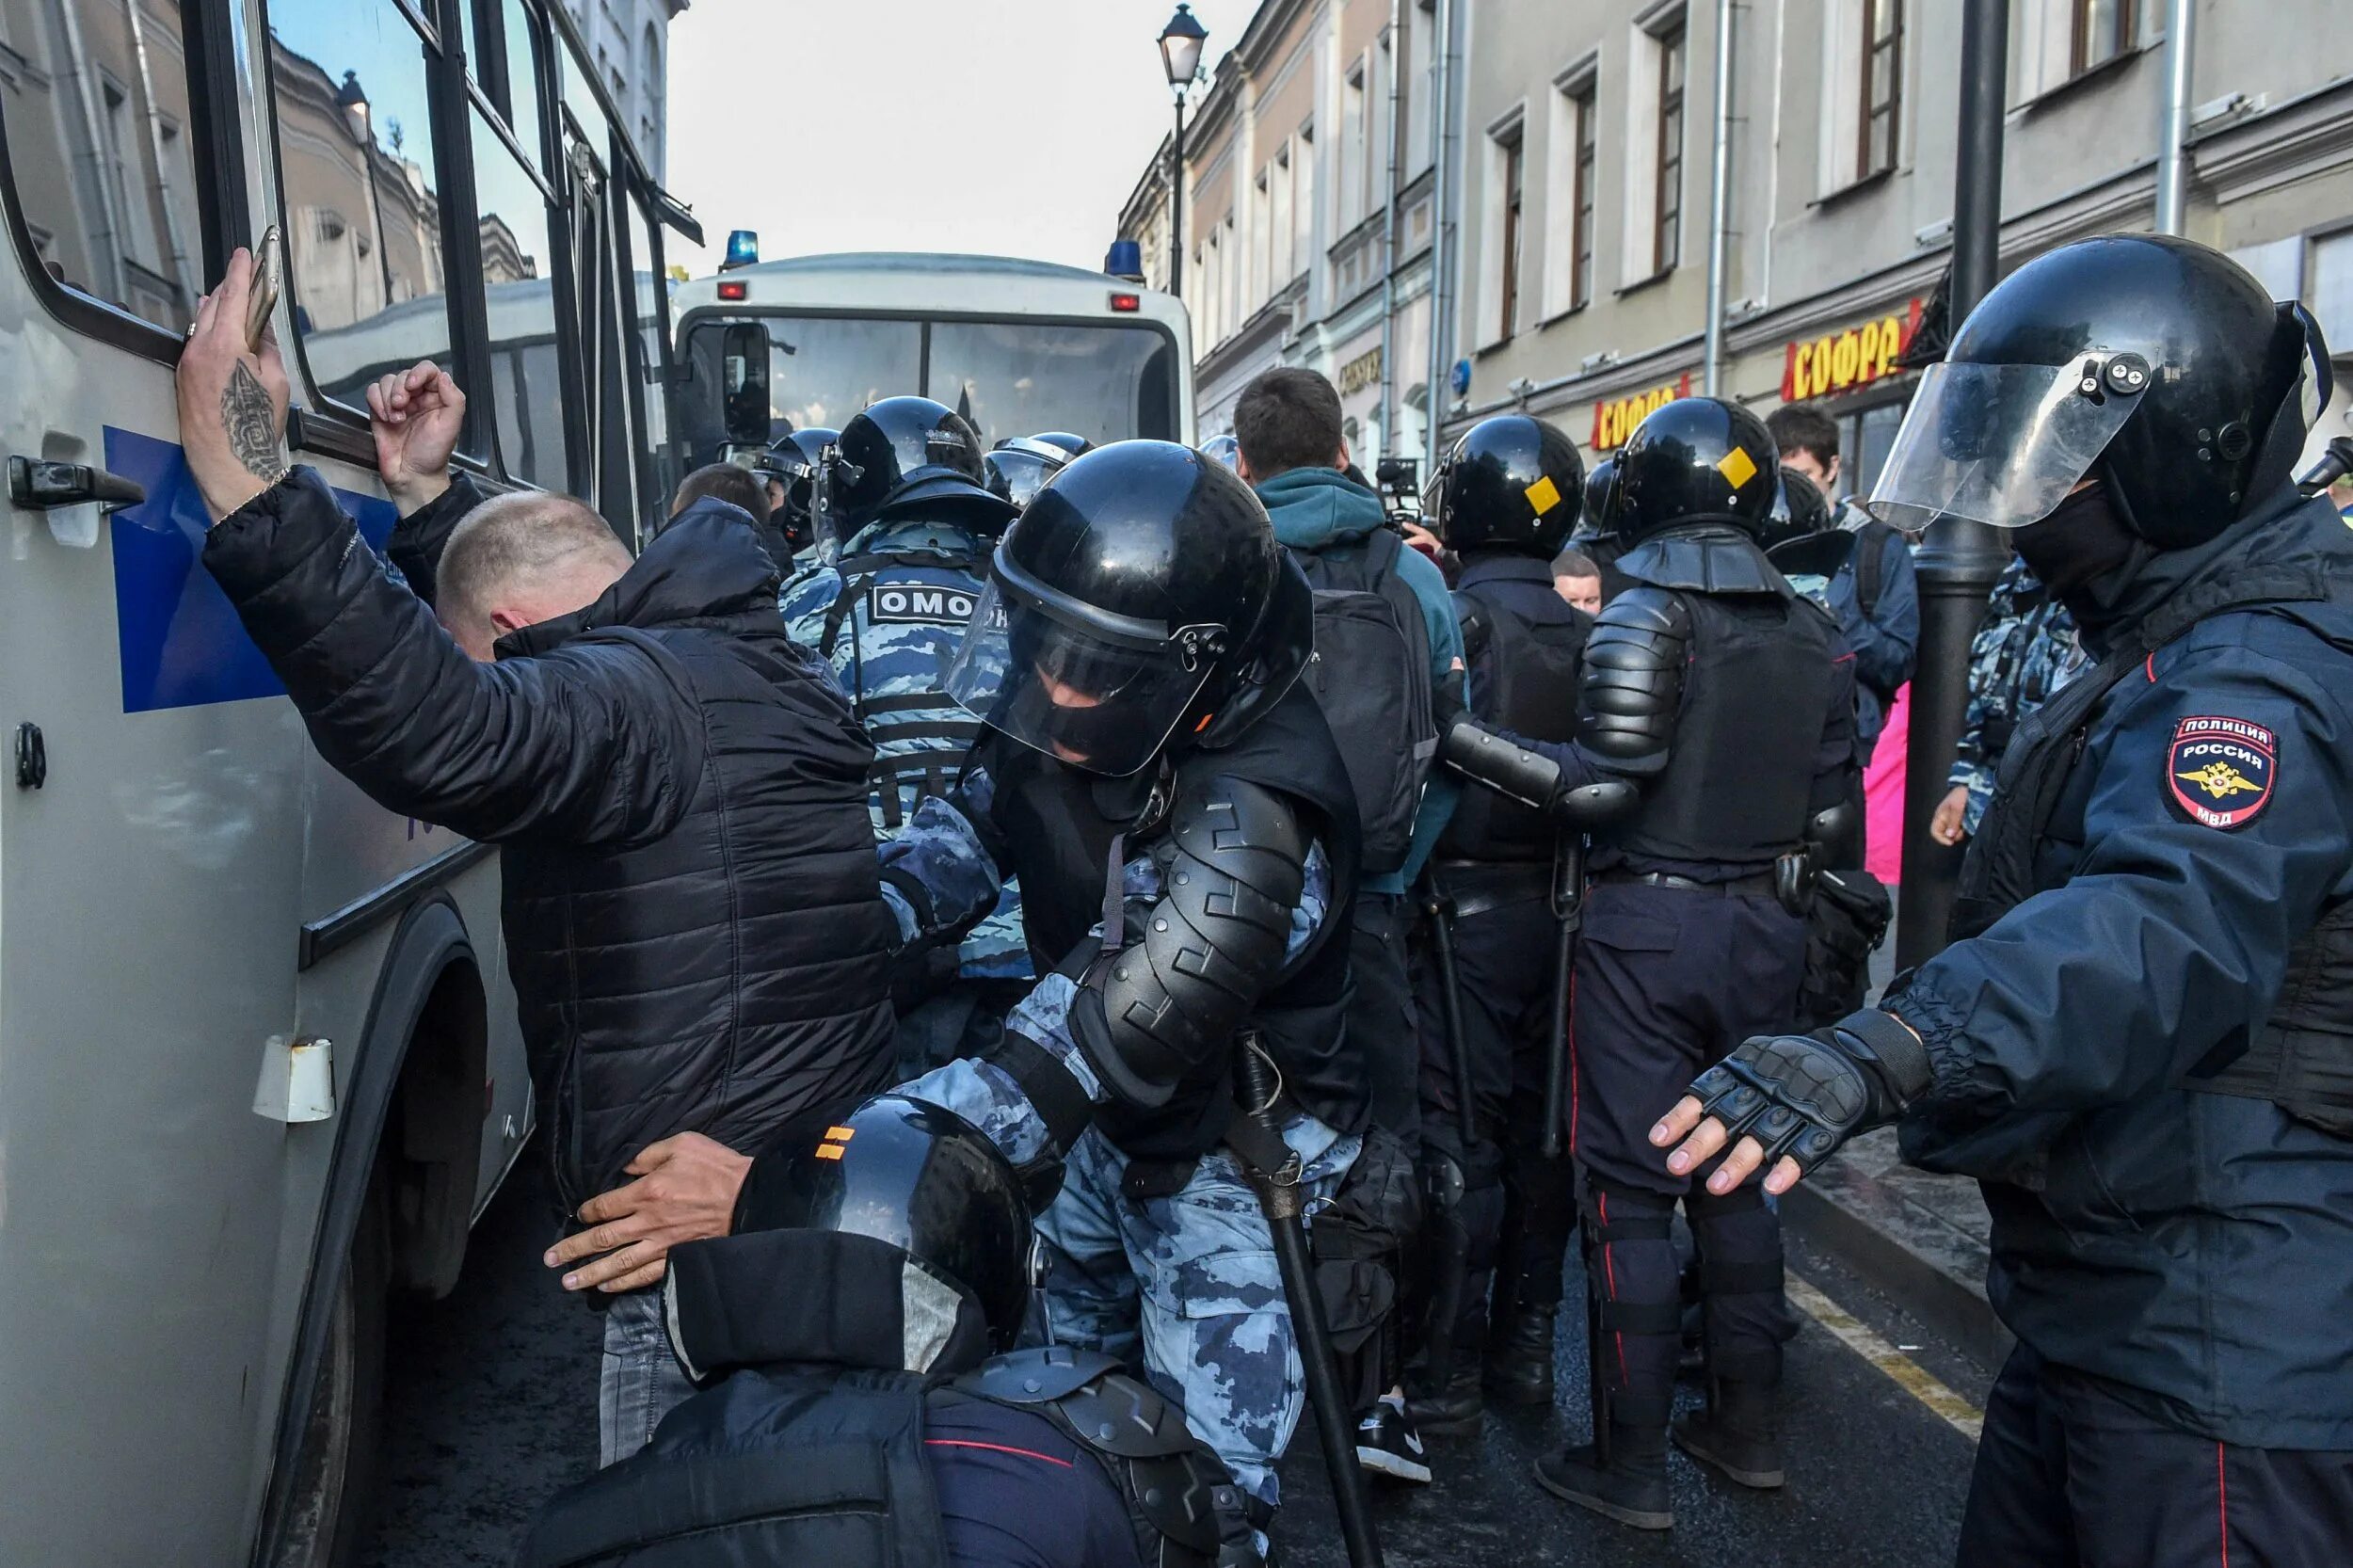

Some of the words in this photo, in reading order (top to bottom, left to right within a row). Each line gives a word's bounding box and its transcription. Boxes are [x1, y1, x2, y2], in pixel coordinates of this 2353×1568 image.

[1794, 315, 1900, 400] СОФРА
[2185, 720, 2268, 744] ПОЛИЦИЯ
[2183, 744, 2263, 770] РОССИЯ
[2196, 807, 2233, 826] МВД
